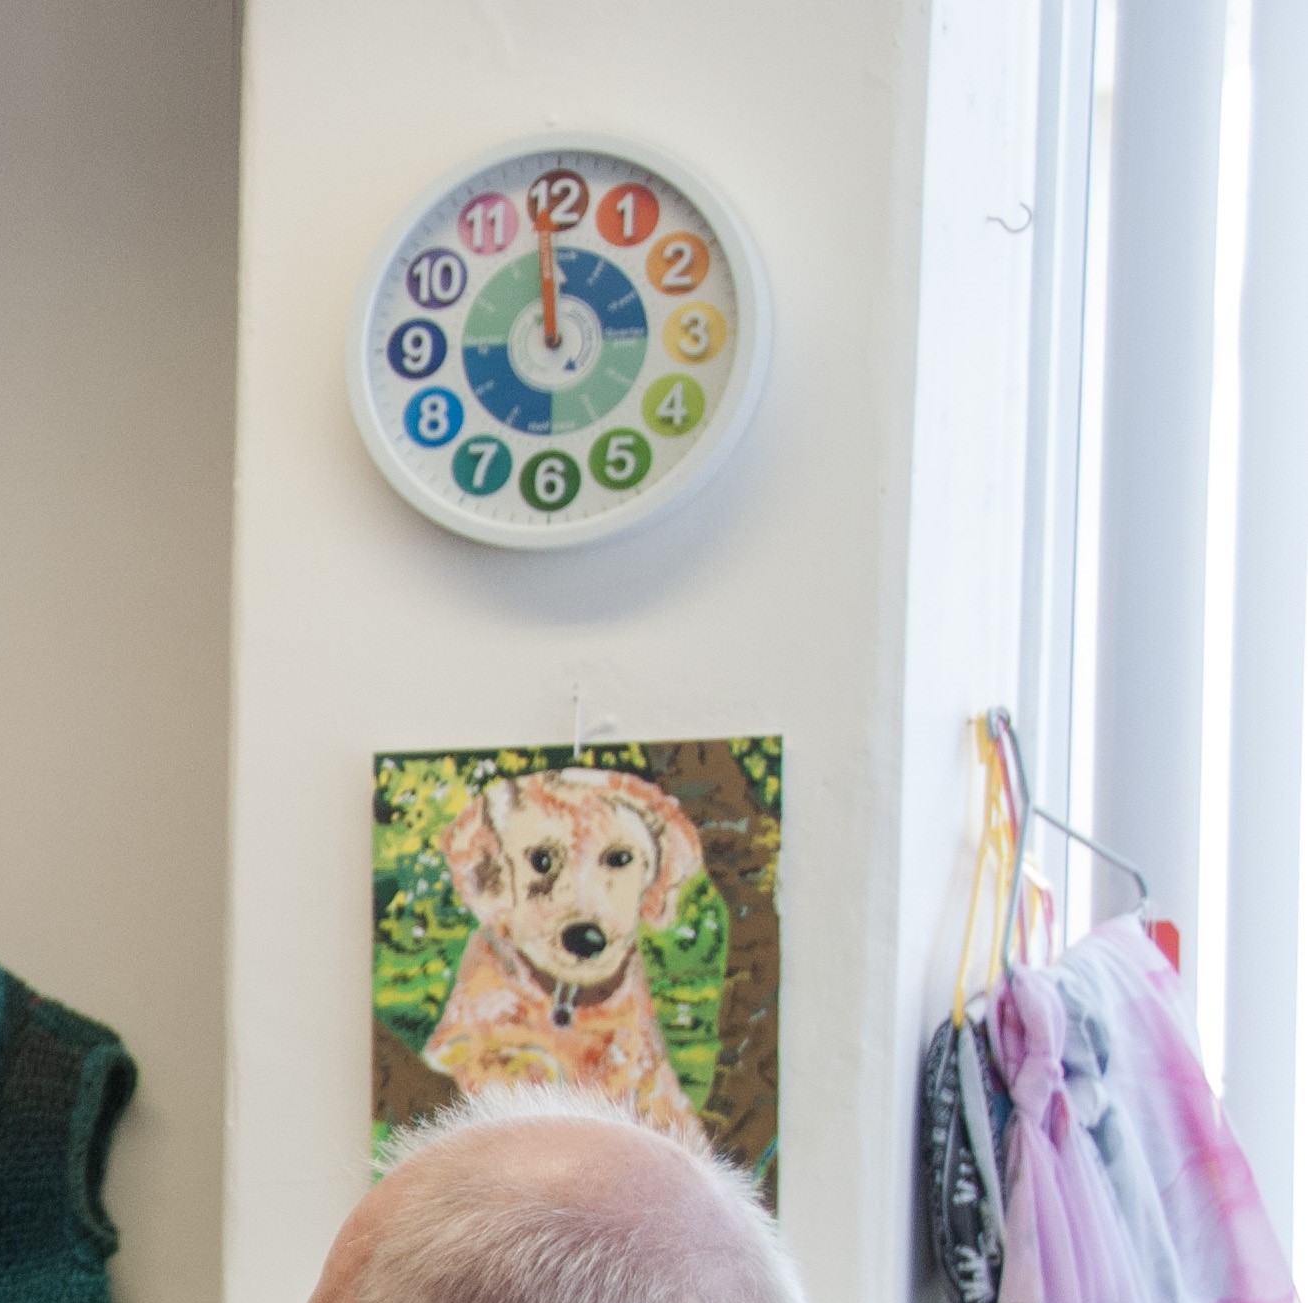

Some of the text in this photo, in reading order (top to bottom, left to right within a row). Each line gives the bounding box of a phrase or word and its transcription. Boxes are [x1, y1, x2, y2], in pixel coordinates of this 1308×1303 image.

[466, 200, 507, 250] 11
[531, 176, 581, 226] 12
[615, 192, 634, 241] 1
[411, 253, 459, 303] 10
[661, 240, 693, 290] 2
[401, 326, 433, 373] 9
[679, 310, 710, 358] 3
[417, 392, 450, 441] 8
[657, 380, 687, 428] 4
[468, 442, 498, 489] 7
[534, 456, 567, 505] 6
[603, 434, 636, 483] 5
